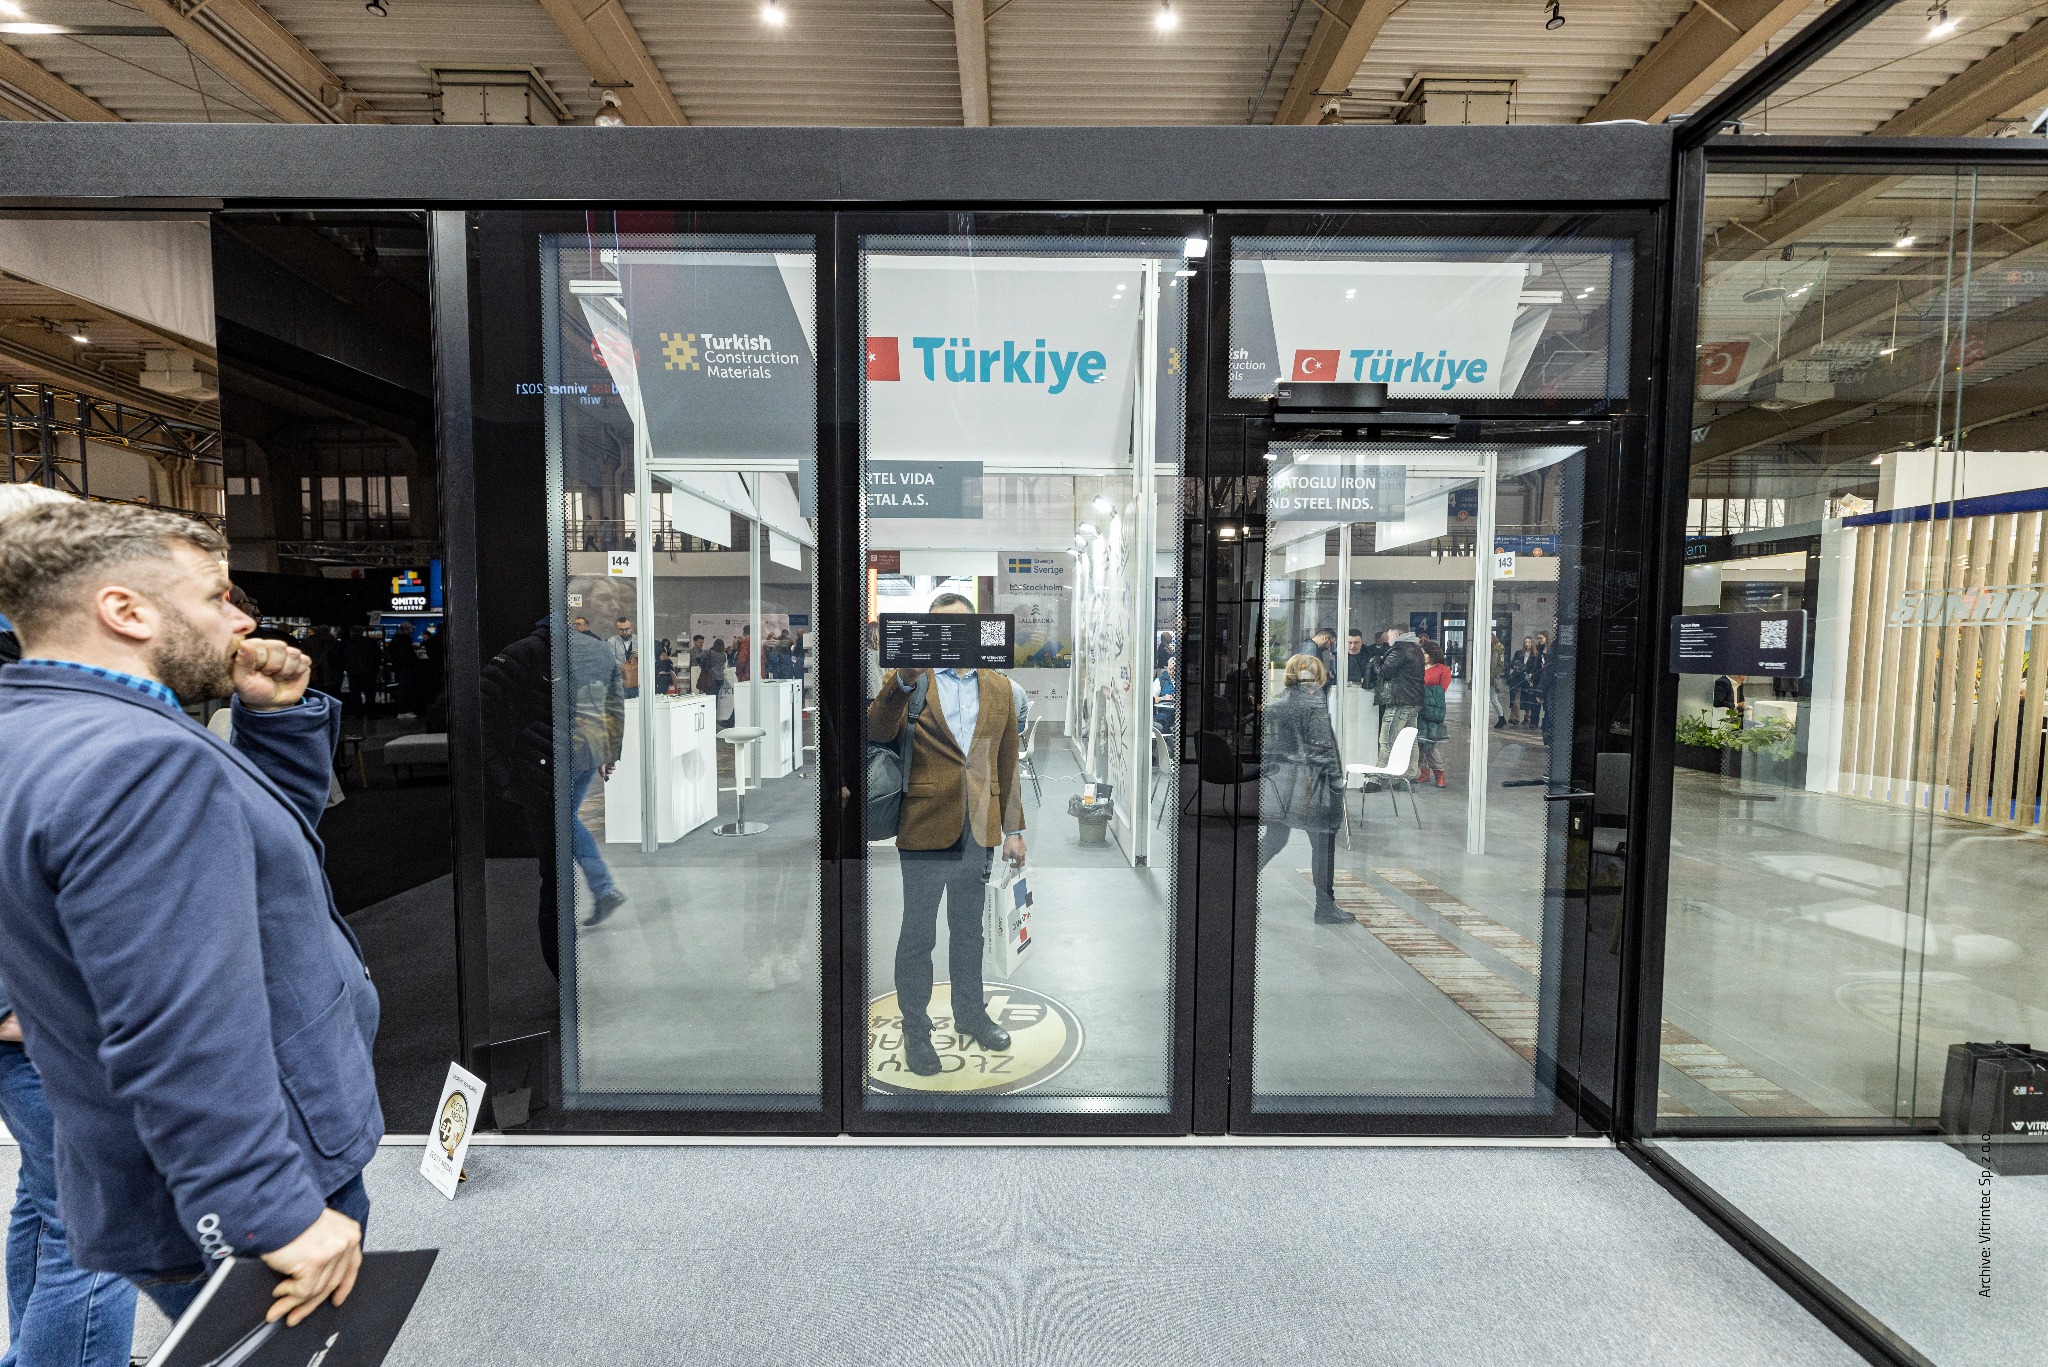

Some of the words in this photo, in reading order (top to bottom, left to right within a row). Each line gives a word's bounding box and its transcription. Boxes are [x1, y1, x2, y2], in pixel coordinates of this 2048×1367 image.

[700, 333, 772, 350] Turkish
[704, 350, 799, 364] Construction
[707, 365, 772, 378] Materials
[912, 336, 1107, 394] Türkiye
[1349, 349, 1488, 391] Türkiye
[899, 472, 935, 485] VIDA
[1266, 477, 1337, 489] KATOGLU
[1340, 477, 1376, 489] IRON
[901, 493, 929, 506] A.S.
[1293, 497, 1333, 509] STEEL
[1336, 497, 1374, 510] INDS.
[611, 556, 630, 567] 144
[1498, 556, 1513, 568] 143
[1033, 565, 1065, 576] Sverige
[1022, 583, 1063, 591] Stockholm
[876, 1053, 1015, 1074] ZŁOY
